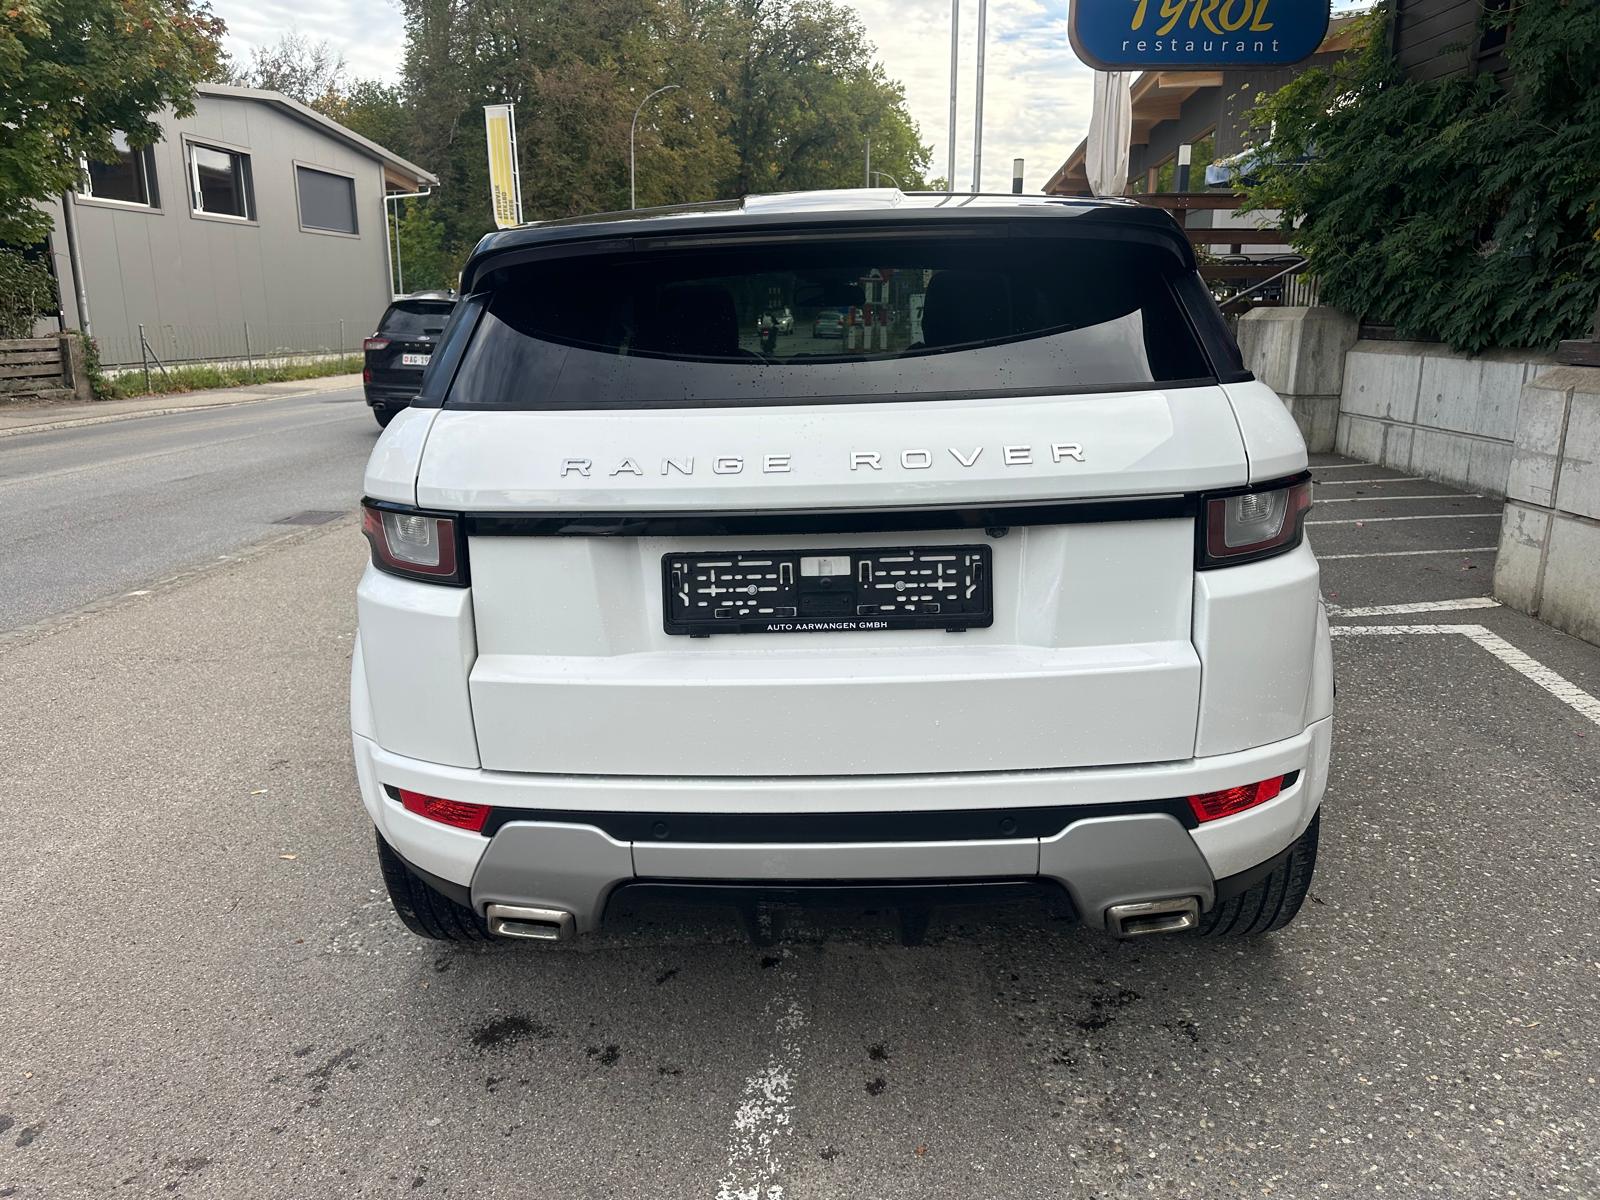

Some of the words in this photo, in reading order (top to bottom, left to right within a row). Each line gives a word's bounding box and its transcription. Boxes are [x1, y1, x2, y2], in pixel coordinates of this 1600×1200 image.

[1121, 38, 1279, 52] restaurant
[560, 453, 792, 477] RANGE
[849, 442, 1086, 470] ROVER
[766, 623, 793, 631] AUTO
[795, 622, 857, 631] AARWANGEN
[859, 621, 888, 629] GMBH
